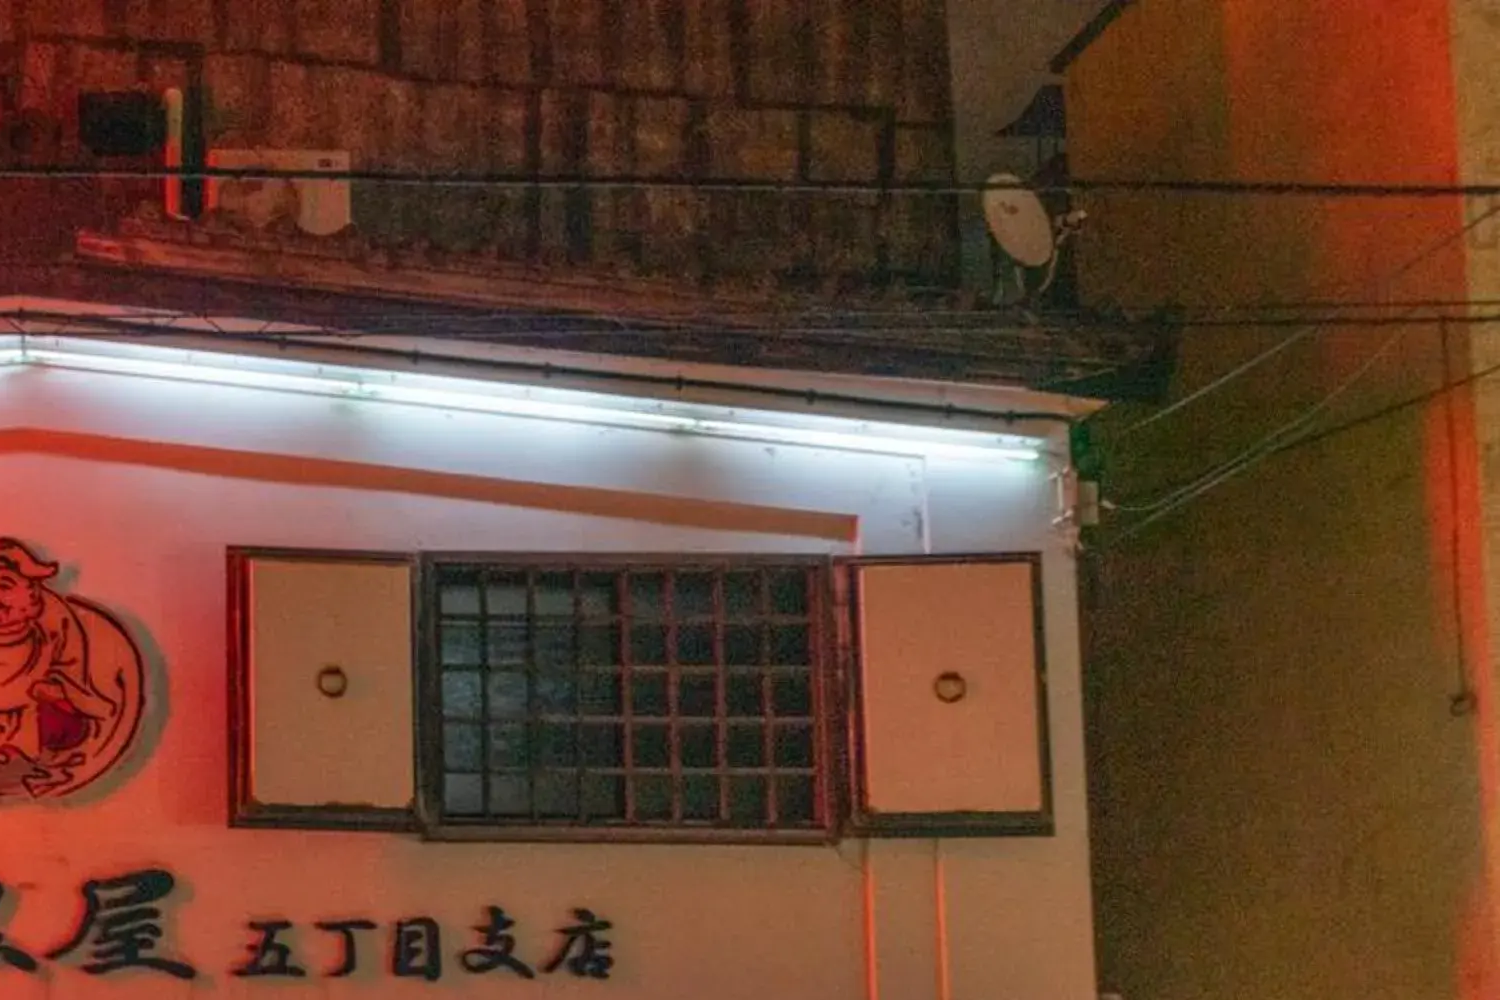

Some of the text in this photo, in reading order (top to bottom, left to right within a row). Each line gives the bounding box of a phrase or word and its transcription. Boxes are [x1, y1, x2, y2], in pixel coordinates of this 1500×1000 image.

[229, 905, 616, 981] 五丁目支店
